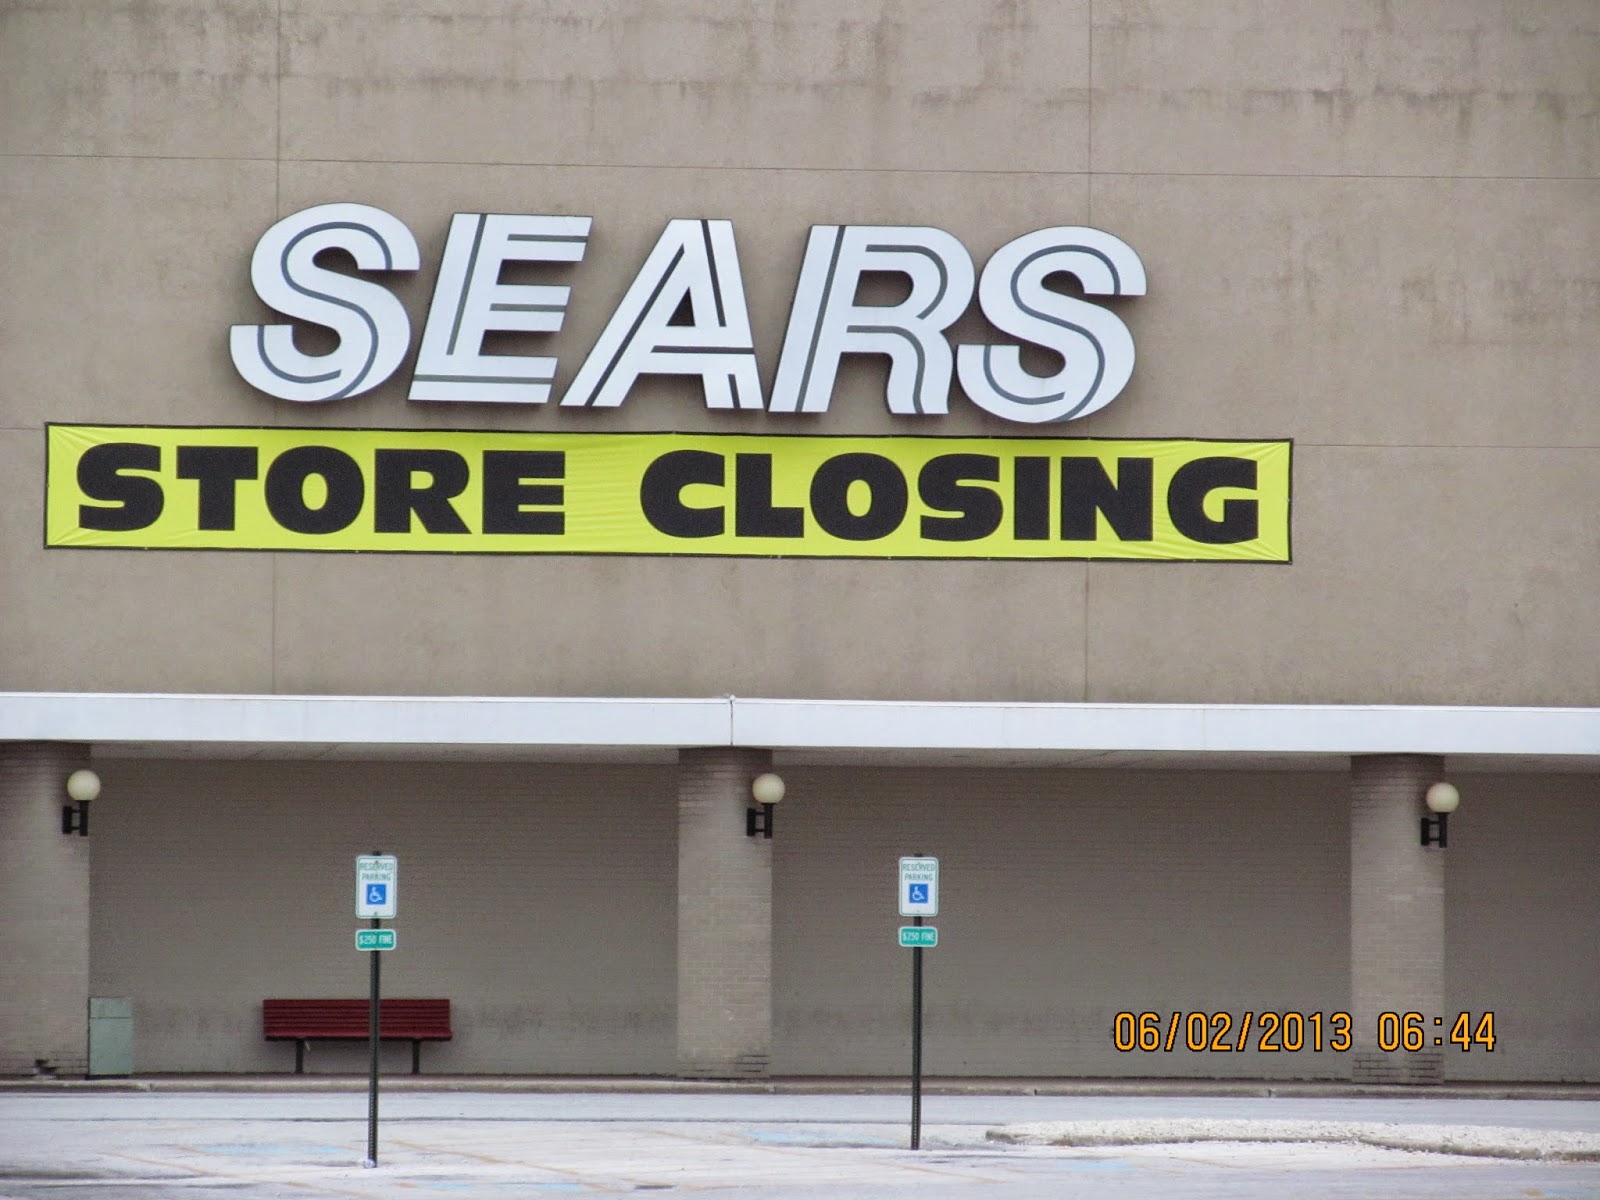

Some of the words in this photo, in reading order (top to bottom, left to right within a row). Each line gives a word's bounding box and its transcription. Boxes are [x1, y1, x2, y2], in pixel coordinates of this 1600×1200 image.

[230, 202, 1147, 423] SEARS
[76, 441, 566, 535] STORE
[640, 449, 1259, 544] CLOSING
[359, 862, 395, 871] RESERVED
[902, 863, 936, 872] RESERVED
[362, 873, 391, 881] PARKING
[904, 873, 933, 881] PARKING
[379, 934, 393, 945] FINE
[921, 931, 935, 942] FINE
